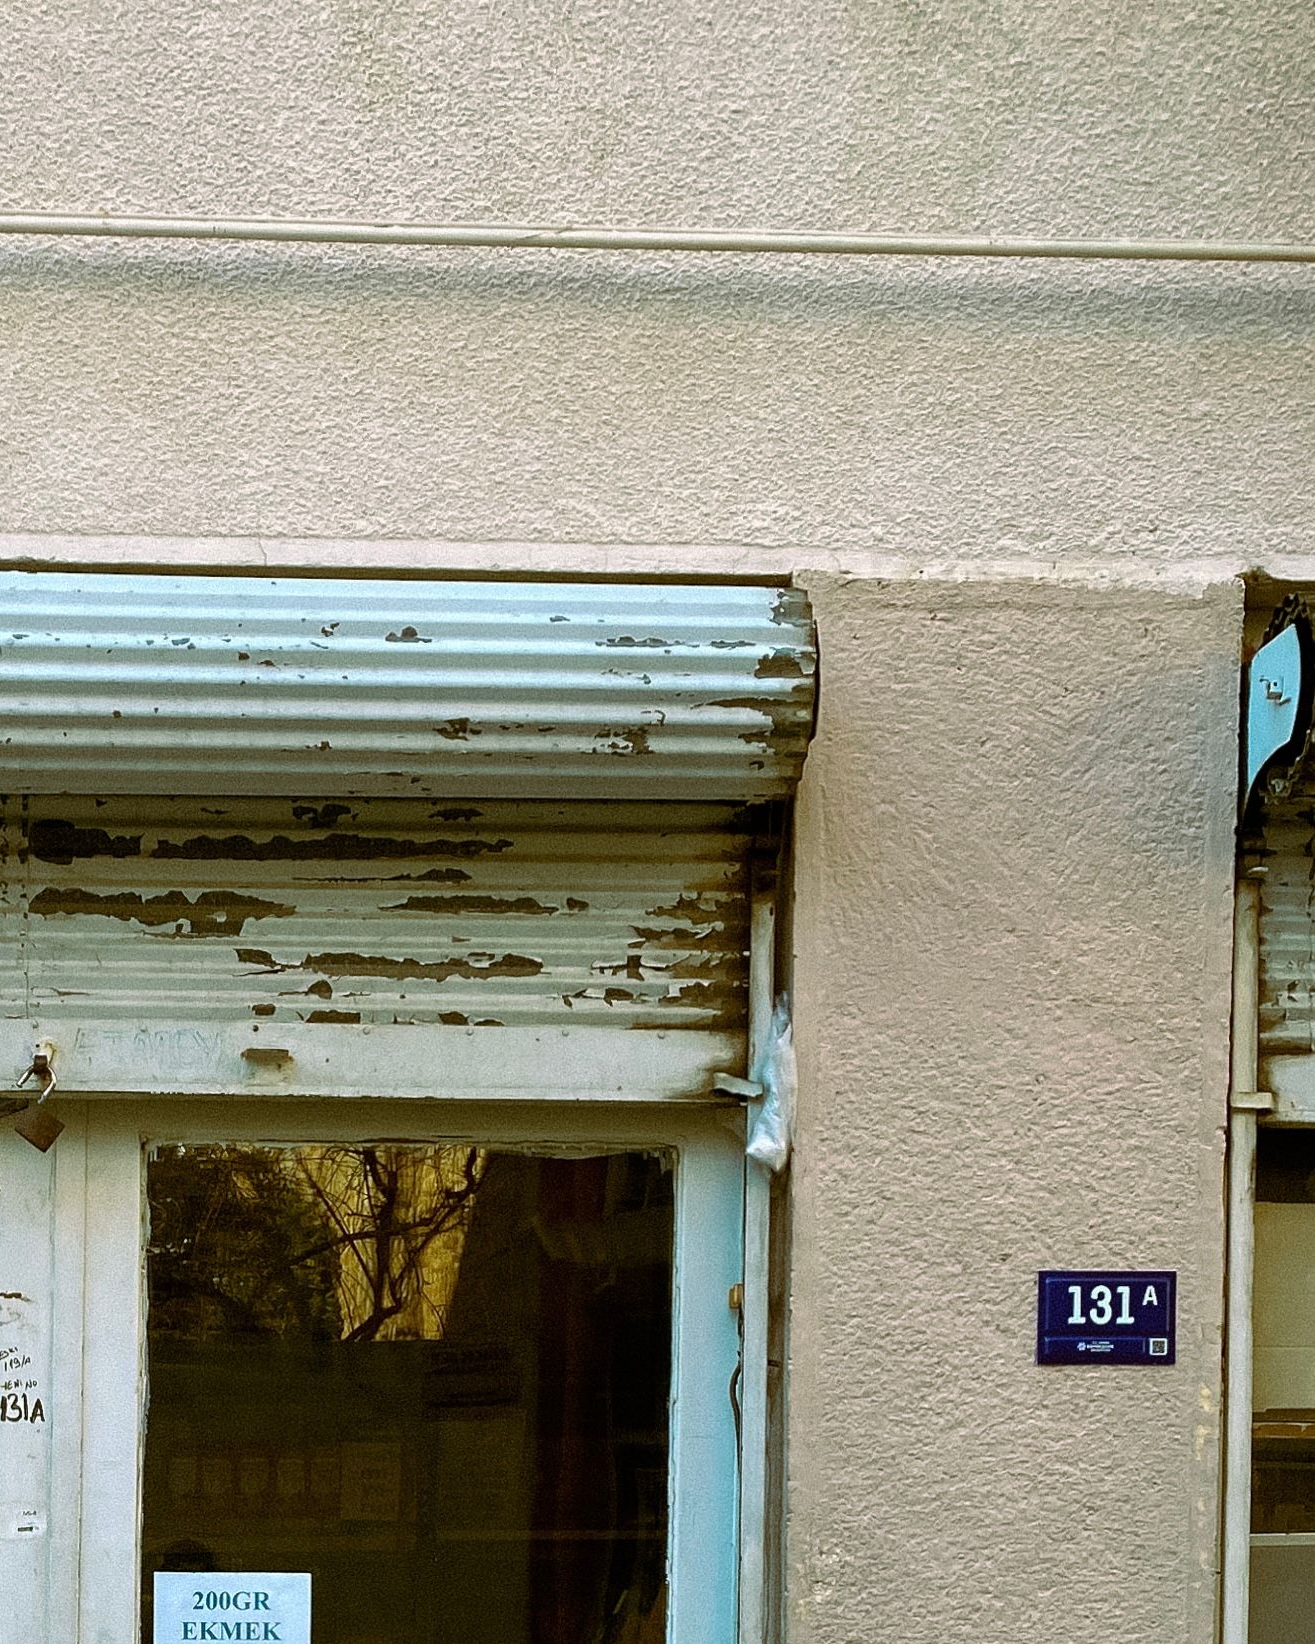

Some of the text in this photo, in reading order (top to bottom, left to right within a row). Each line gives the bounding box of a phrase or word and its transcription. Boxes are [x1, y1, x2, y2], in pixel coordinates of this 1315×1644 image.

[1067, 1285, 1158, 1325] 131 A
[192, 1591, 271, 1611] 200GR
[181, 1621, 282, 1641] EKMEK
